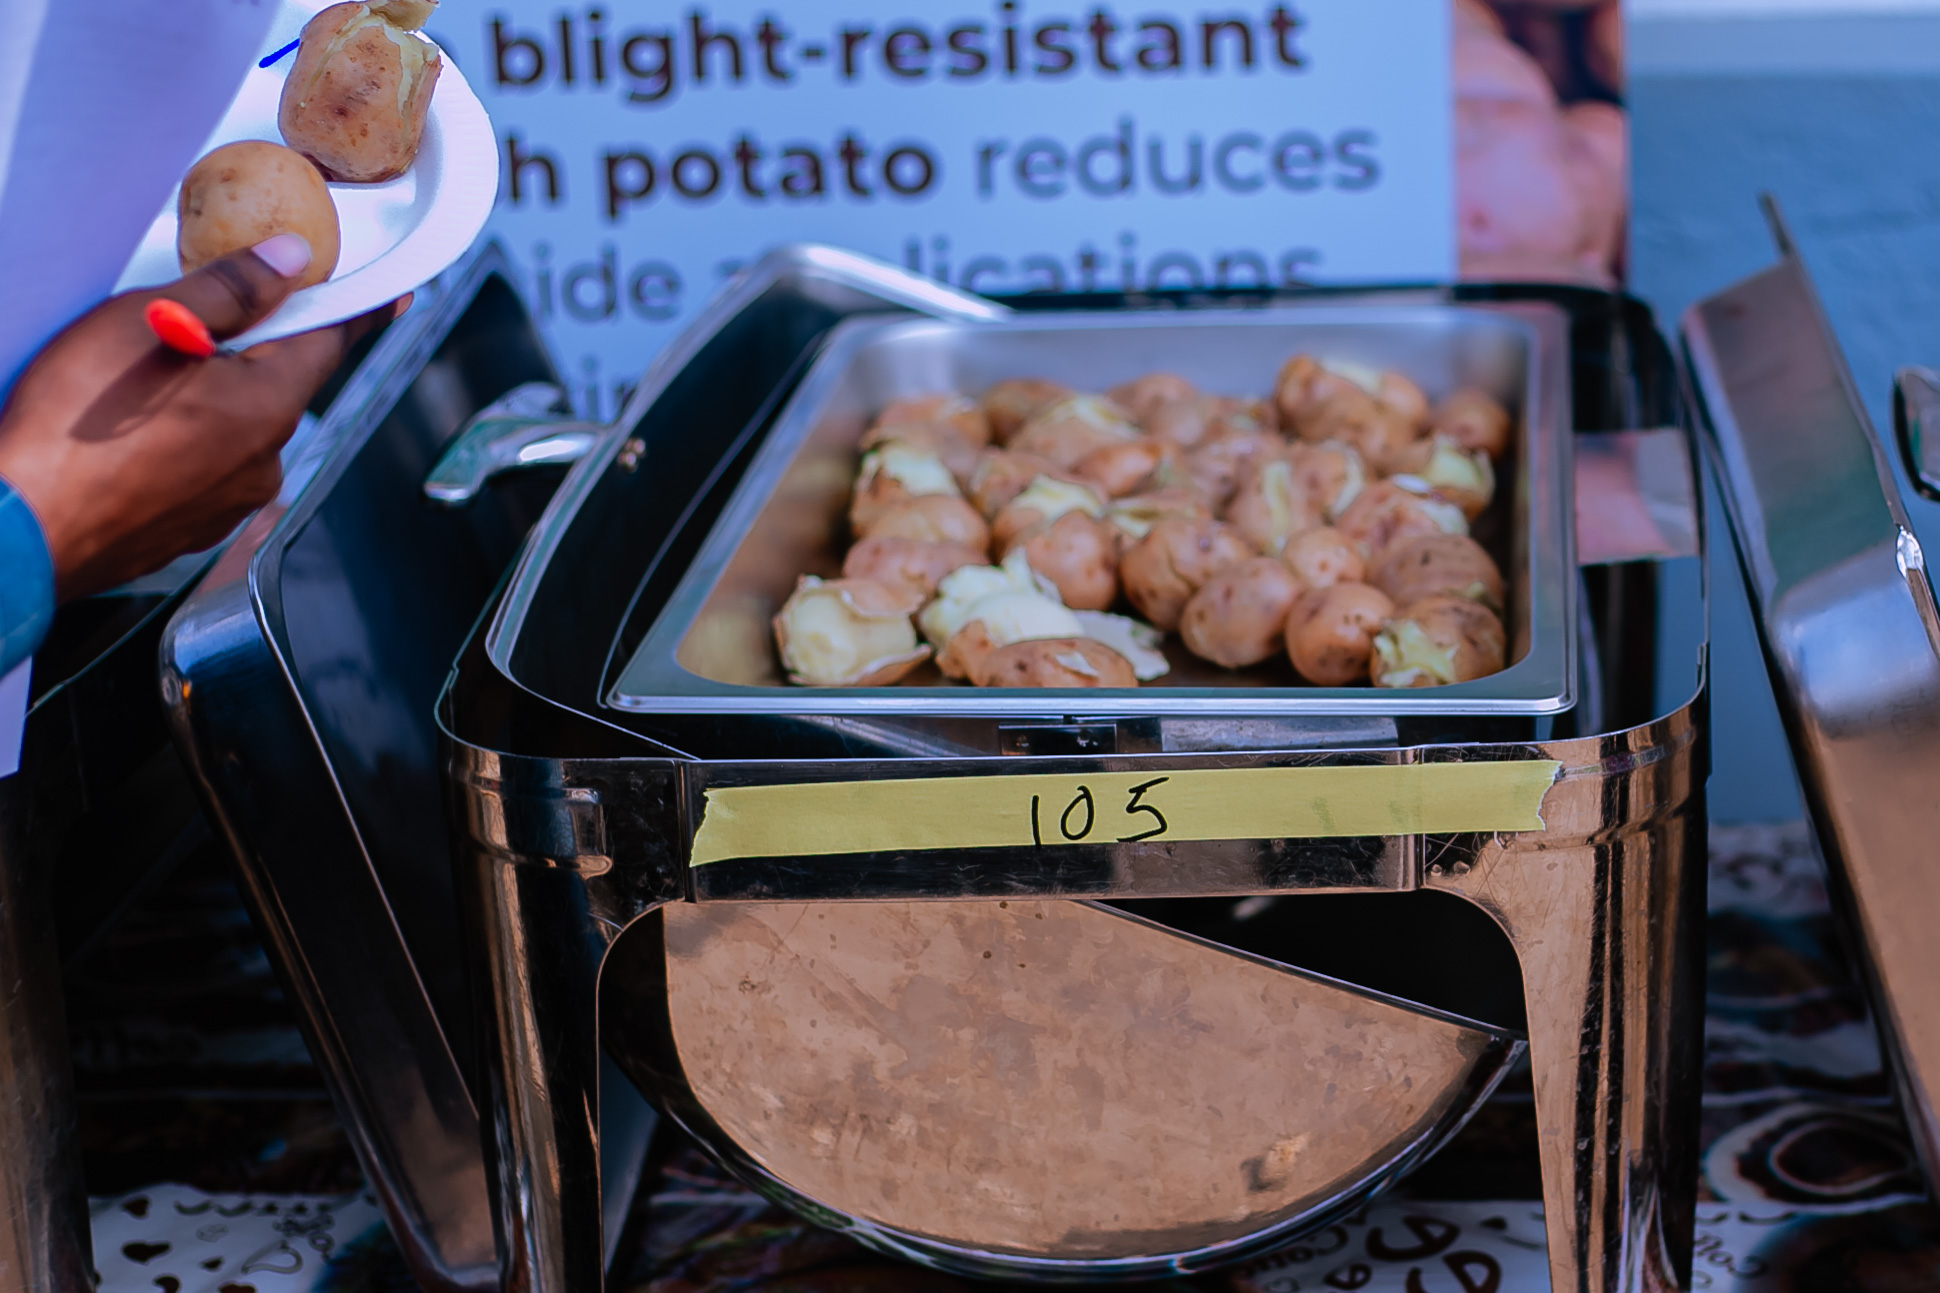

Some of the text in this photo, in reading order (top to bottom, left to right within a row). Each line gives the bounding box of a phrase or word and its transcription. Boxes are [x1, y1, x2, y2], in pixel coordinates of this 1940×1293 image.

[488, 2, 1307, 102] blight-resistant
[604, 133, 935, 220] potato
[976, 113, 1381, 198] reduces
[534, 242, 684, 324] ide
[1031, 776, 1170, 848] 105
